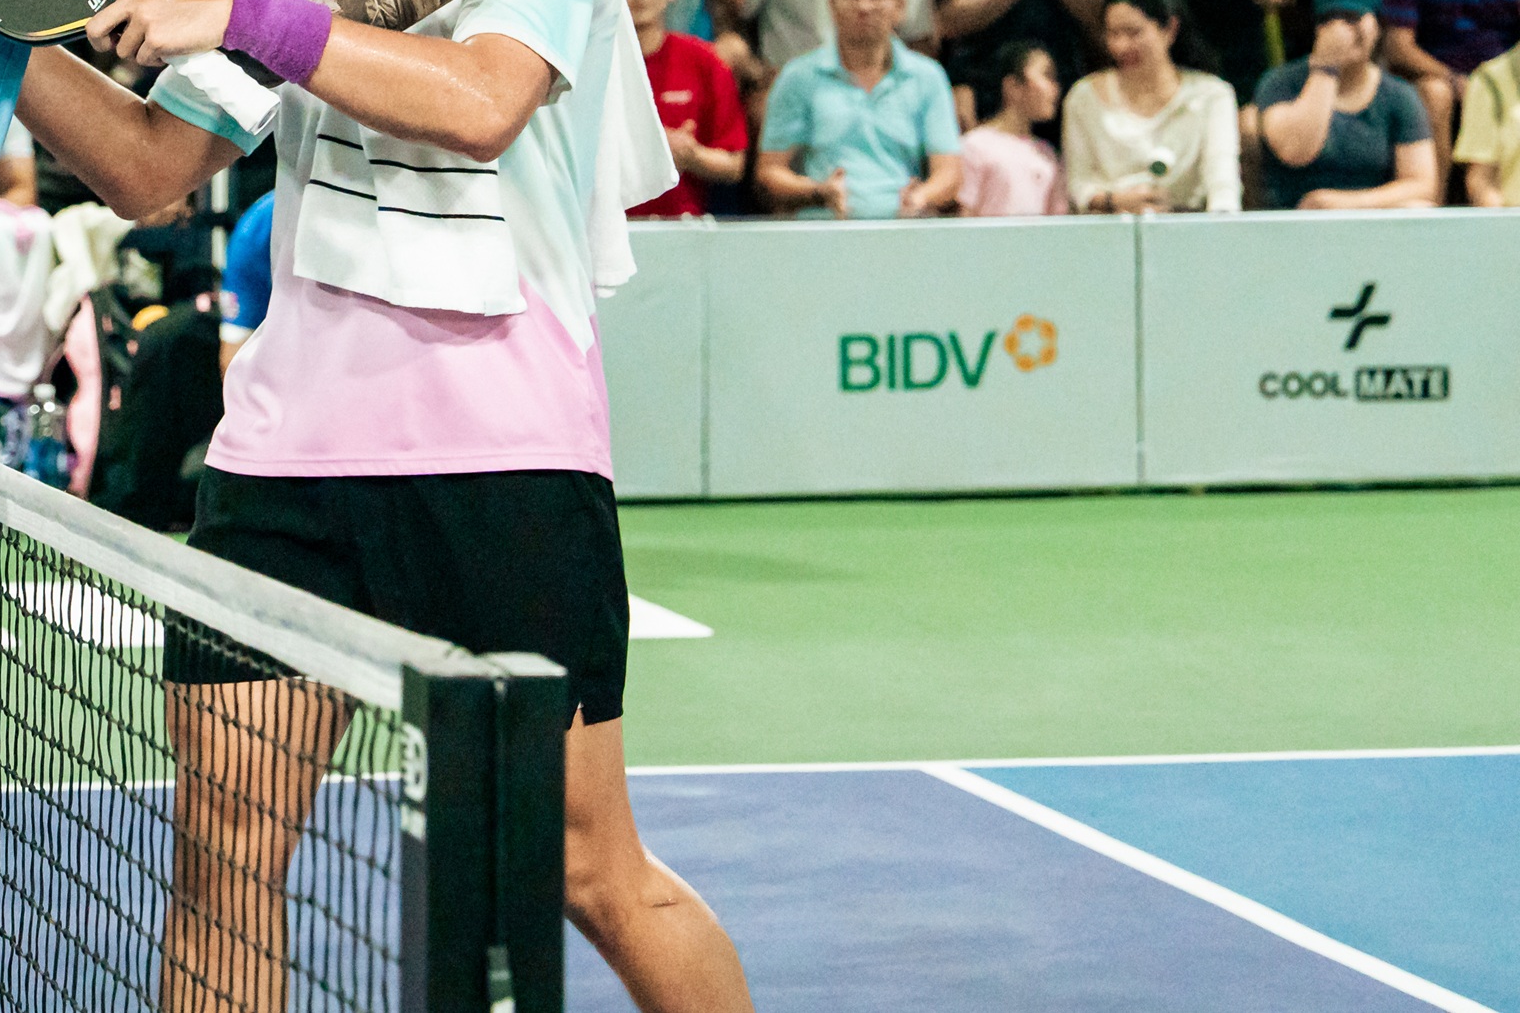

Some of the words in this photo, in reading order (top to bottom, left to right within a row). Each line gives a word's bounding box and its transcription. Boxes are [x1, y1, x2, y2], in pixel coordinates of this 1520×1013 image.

[839, 330, 997, 392] BIDV
[1258, 371, 1348, 399] COOL
[1356, 367, 1447, 400] MATE
